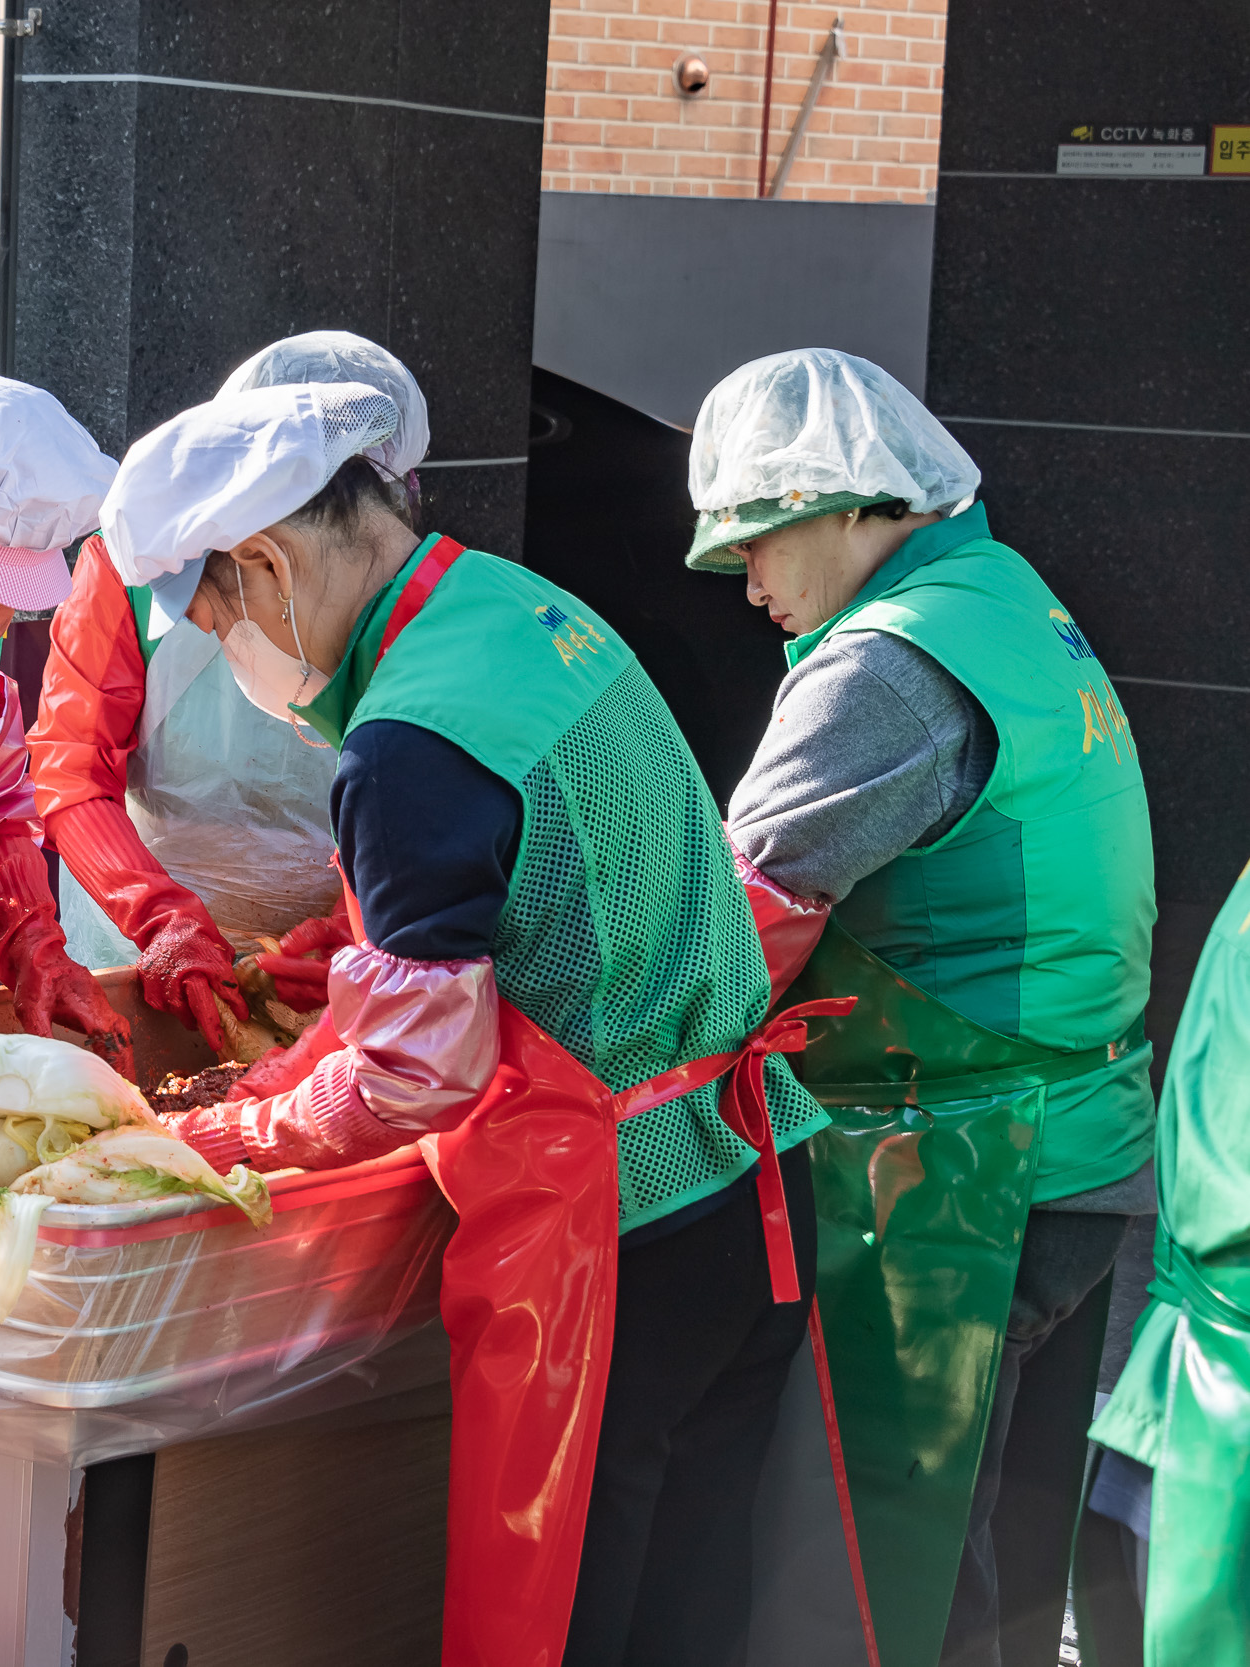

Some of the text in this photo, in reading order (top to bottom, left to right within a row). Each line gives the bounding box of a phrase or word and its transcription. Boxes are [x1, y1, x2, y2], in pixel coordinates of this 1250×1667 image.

[1101, 127, 1196, 141] CCTV 녹화중
[535, 604, 568, 632] SMU
